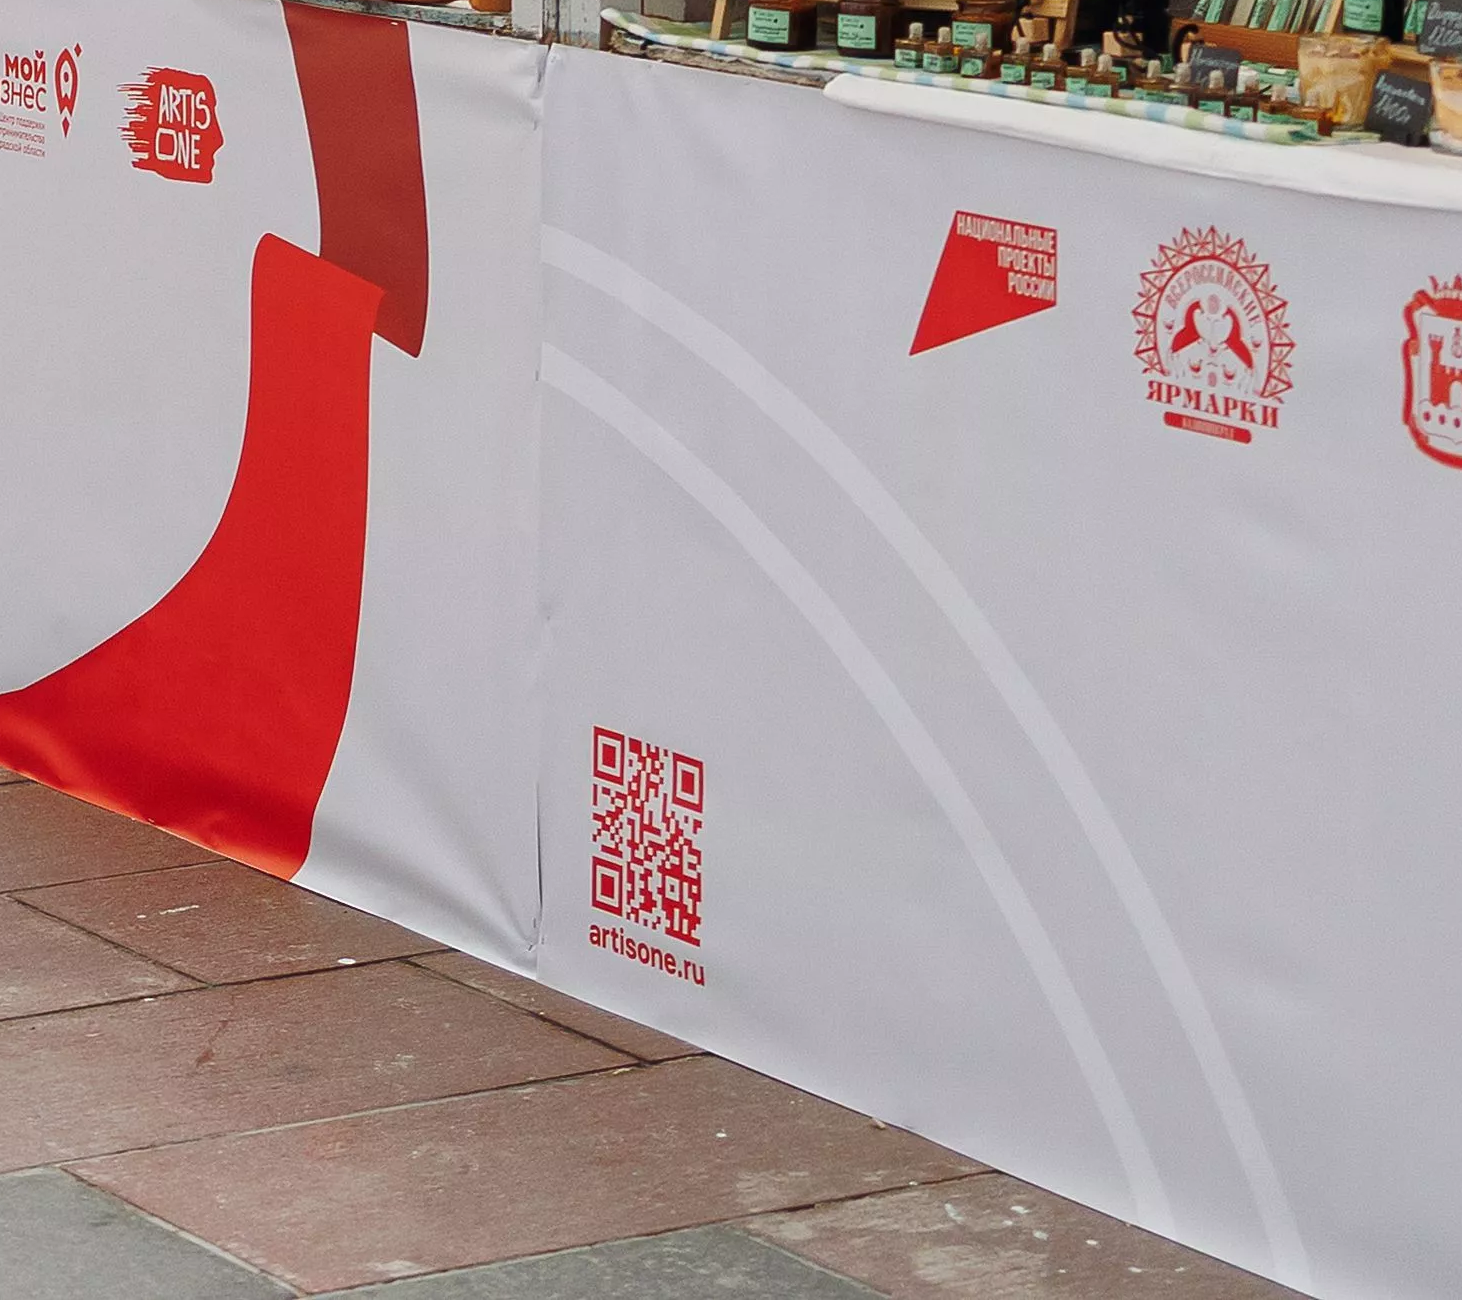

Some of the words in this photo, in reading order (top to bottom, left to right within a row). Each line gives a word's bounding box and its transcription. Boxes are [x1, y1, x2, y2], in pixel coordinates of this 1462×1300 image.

[5, 50, 46, 84] мой
[158, 82, 211, 131] ARTIS
[155, 128, 201, 170] ONE
[957, 213, 1055, 254] НАЦИОНАЛЬНЫЕ
[997, 245, 1055, 278] ПРОЕКТЫ
[1007, 271, 1055, 302] РОССИИ
[1146, 379, 1279, 429] ЯРМАРКИ
[589, 923, 705, 986] artisone.ru
